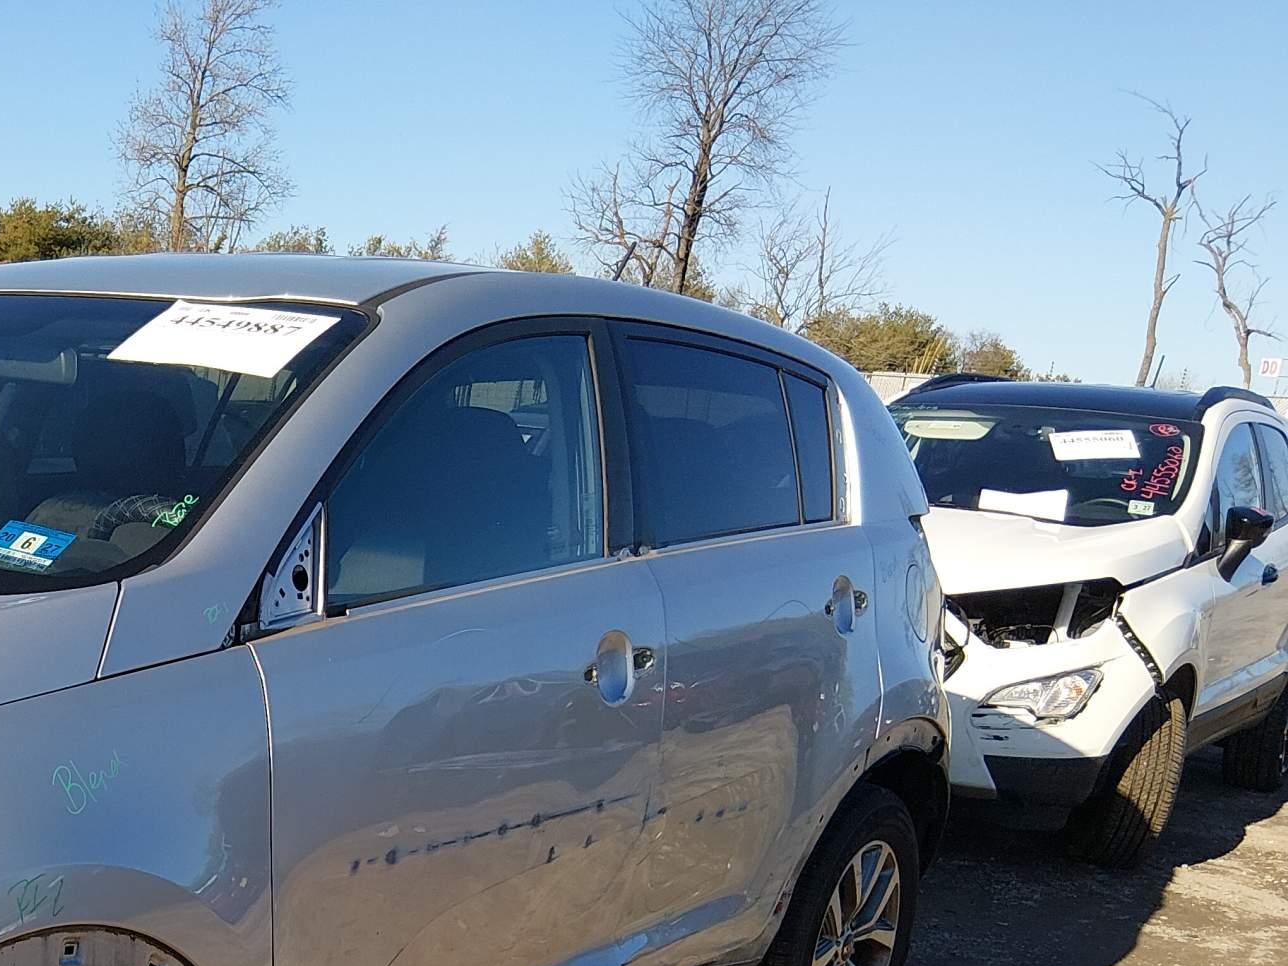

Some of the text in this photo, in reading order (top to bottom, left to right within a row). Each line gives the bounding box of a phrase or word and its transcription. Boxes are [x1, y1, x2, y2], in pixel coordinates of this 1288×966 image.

[169, 315, 303, 336] 44549887
[20, 536, 37, 550] 6
[40, 542, 62, 553] 27
